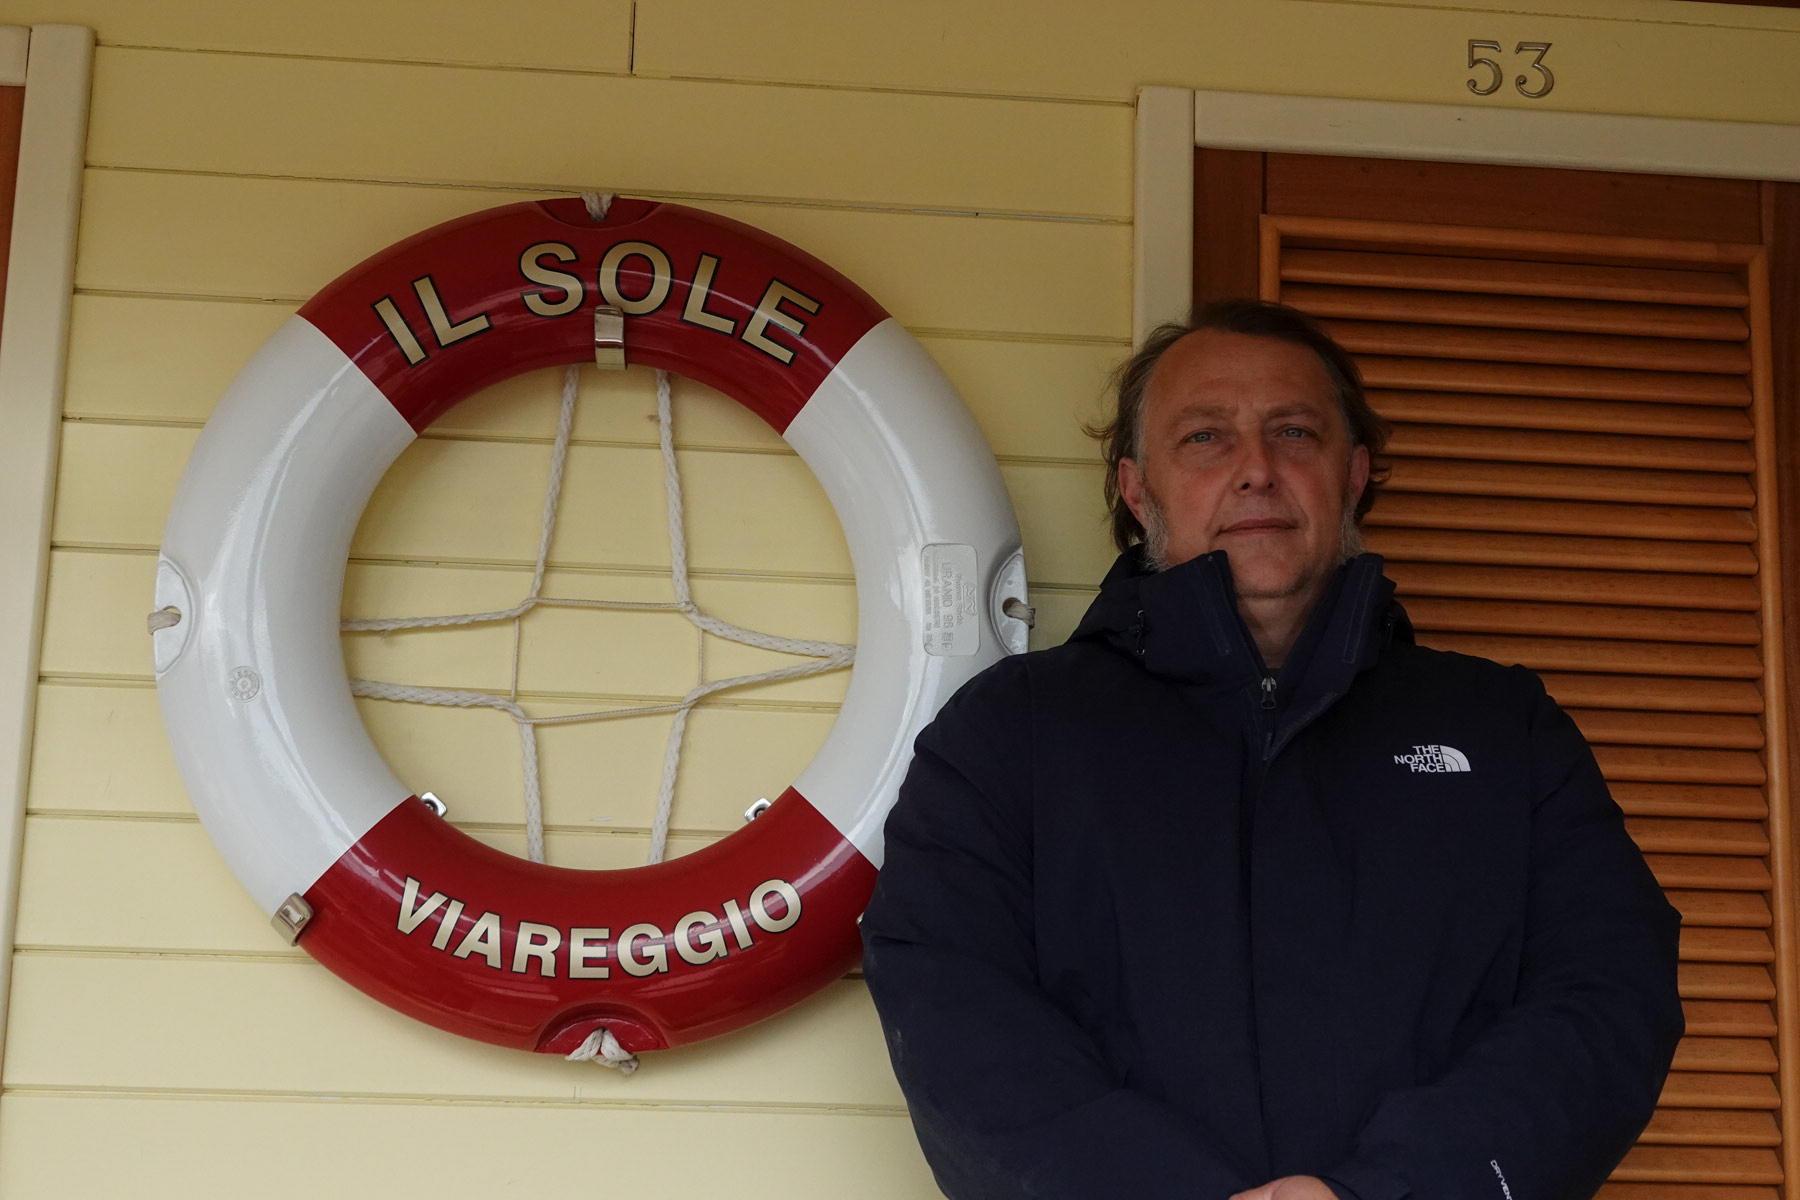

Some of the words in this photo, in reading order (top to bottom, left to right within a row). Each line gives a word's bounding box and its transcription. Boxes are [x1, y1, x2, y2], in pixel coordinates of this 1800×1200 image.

[1467, 39, 1554, 99] 53
[373, 274, 492, 367] IL
[519, 240, 823, 366] SOLE
[1393, 753, 1443, 764] NORTH
[1410, 763, 1445, 773] FACE
[1412, 745, 1440, 755] THE
[397, 876, 802, 979] VIAREGGIO
[1490, 1159, 1513, 1200] DRYVEN
